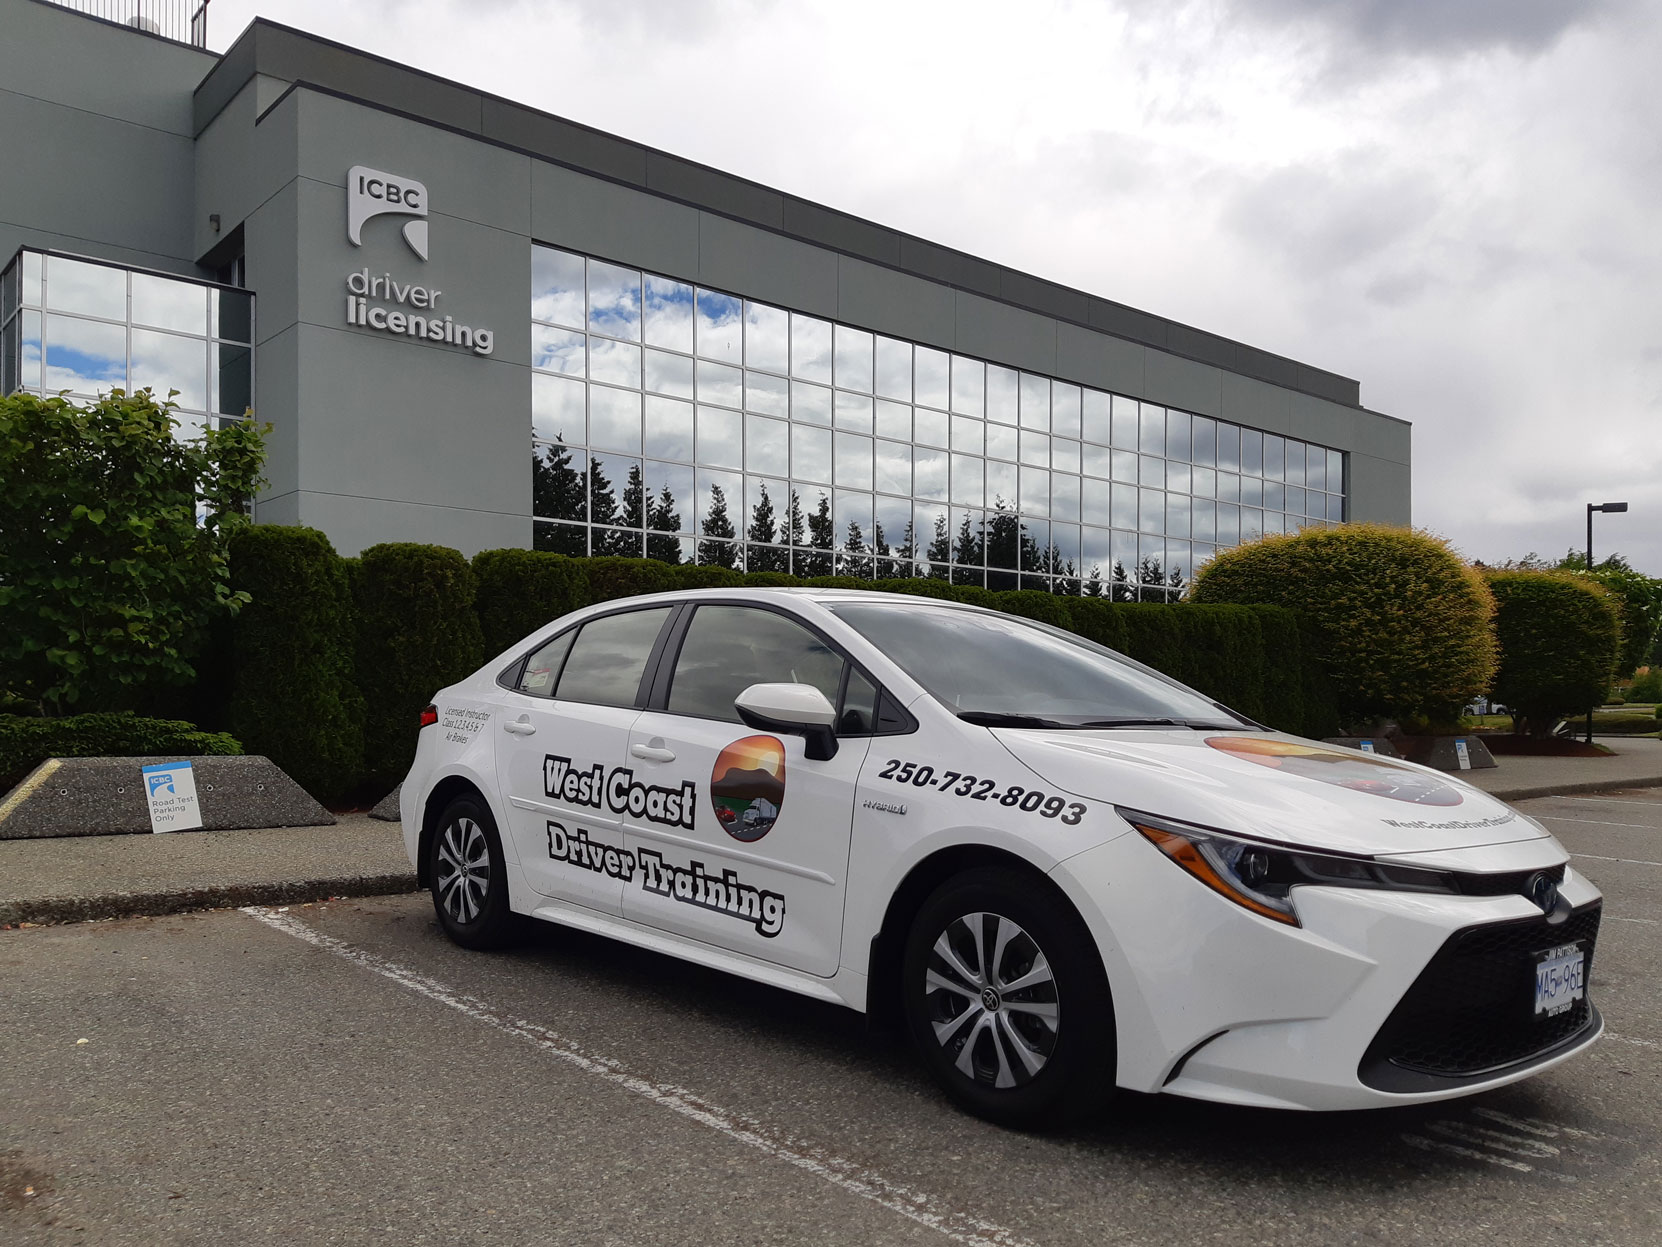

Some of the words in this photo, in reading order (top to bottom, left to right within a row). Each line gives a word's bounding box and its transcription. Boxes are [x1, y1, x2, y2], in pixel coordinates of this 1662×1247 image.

[359, 175, 420, 209] ICBC
[346, 267, 442, 309] driver
[347, 295, 494, 355] licensing
[445, 706, 467, 717] Licensed
[465, 708, 491, 721] Instructor
[442, 717, 454, 728] Class
[451, 732, 469, 744] Brakes
[151, 776, 171, 784] ICBC
[543, 754, 604, 809] West
[606, 766, 696, 830] Coast
[878, 759, 1088, 826] 250-732-8093
[152, 798, 175, 807] Road
[176, 796, 194, 804] Test
[153, 805, 186, 814] Parking
[154, 814, 175, 823] Only
[546, 820, 636, 883] Driver
[637, 847, 786, 938] Training
